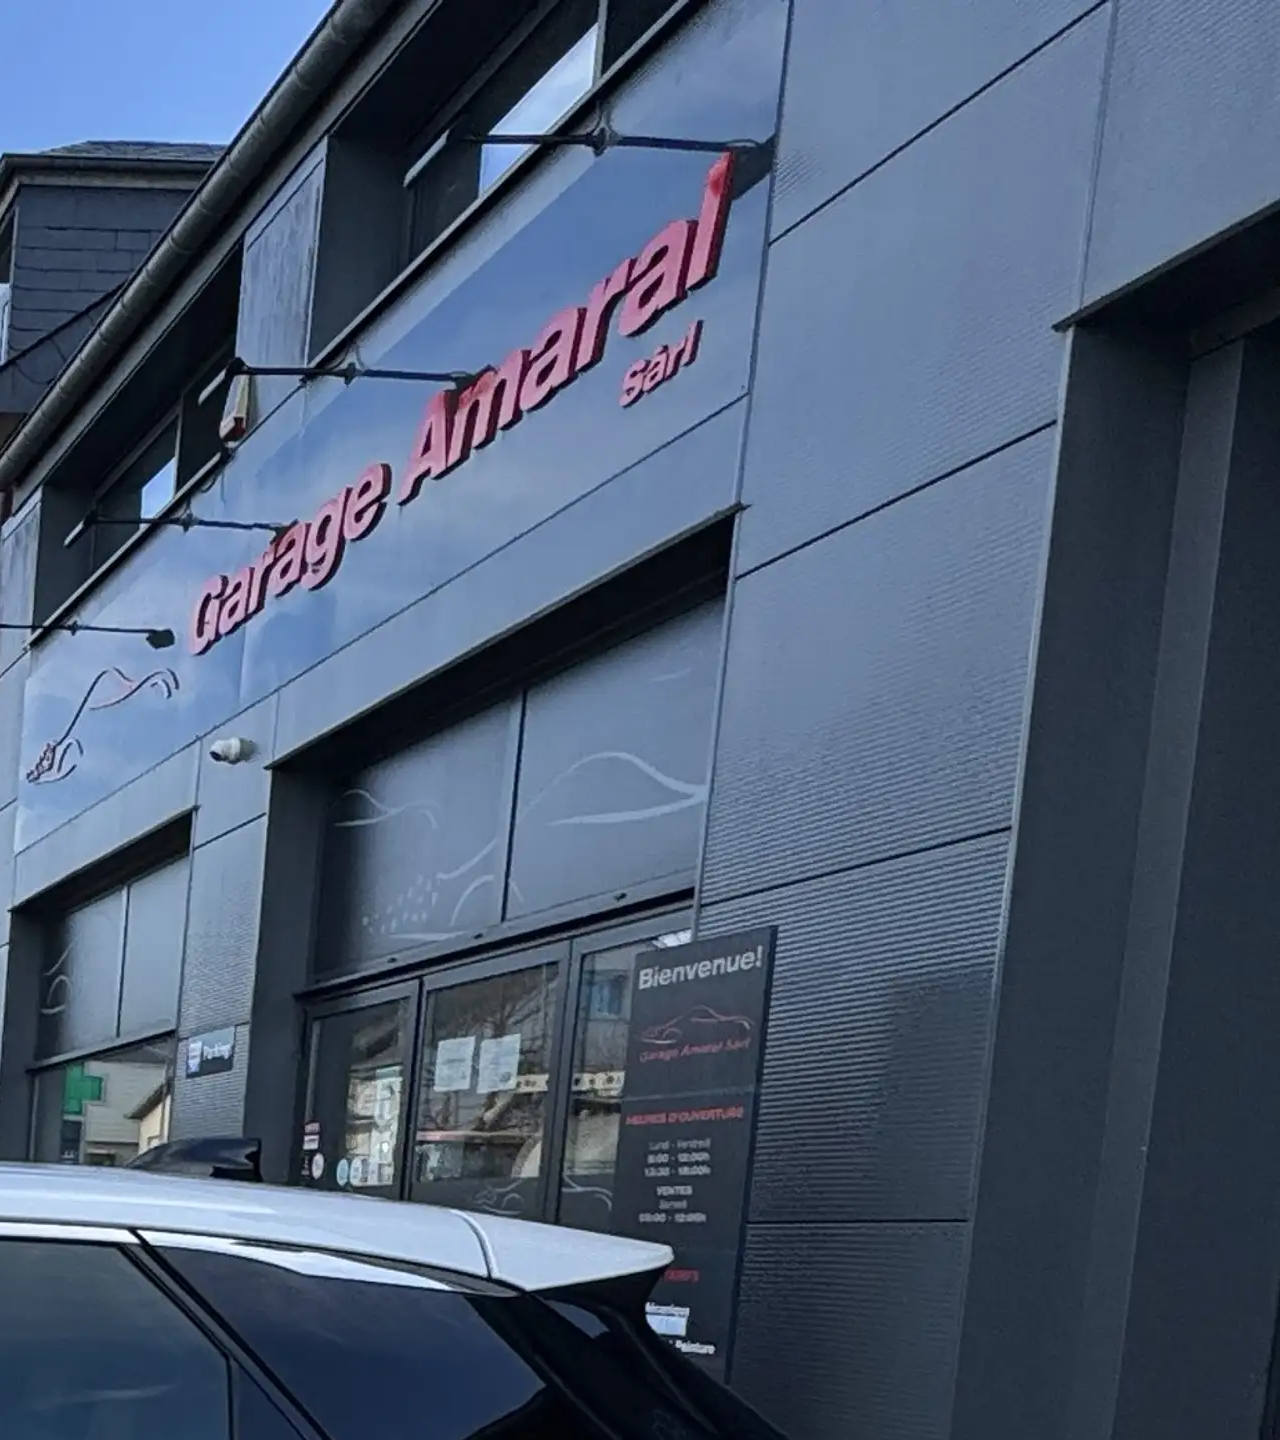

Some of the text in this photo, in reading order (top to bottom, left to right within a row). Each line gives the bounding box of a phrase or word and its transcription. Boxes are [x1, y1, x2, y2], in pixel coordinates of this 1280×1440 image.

[188, 150, 733, 656] Garage Amaral
[638, 945, 764, 991] Bienvenue!
